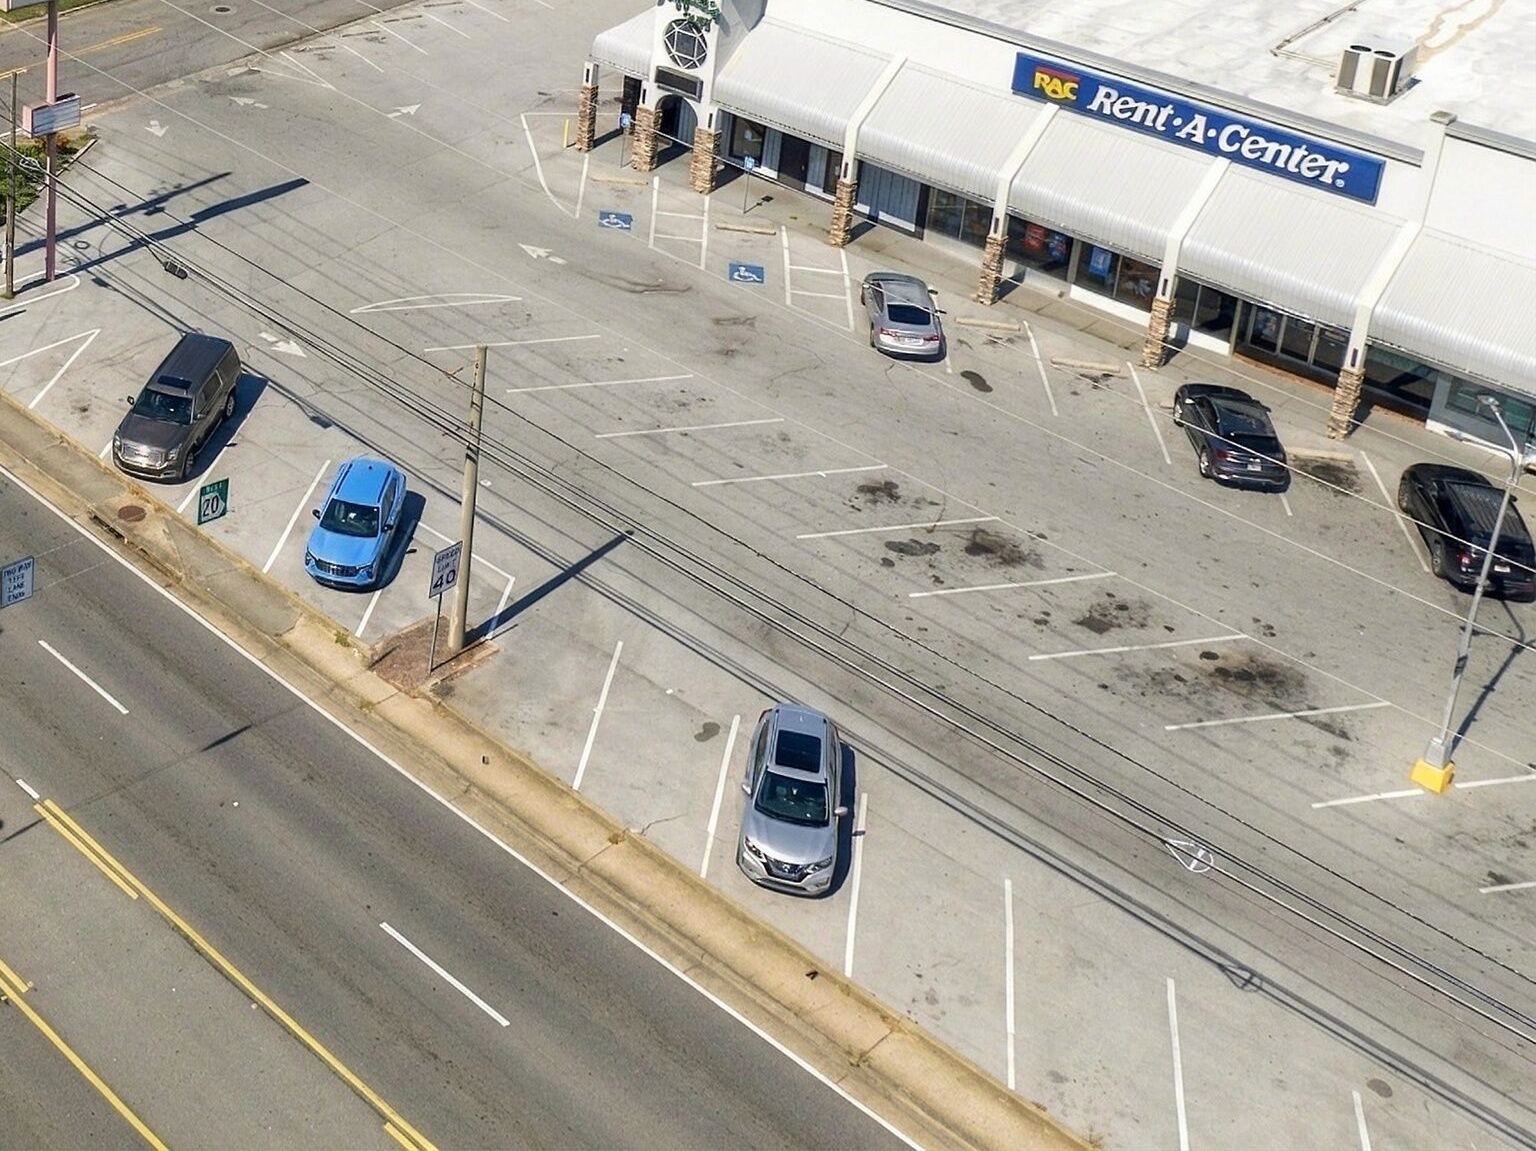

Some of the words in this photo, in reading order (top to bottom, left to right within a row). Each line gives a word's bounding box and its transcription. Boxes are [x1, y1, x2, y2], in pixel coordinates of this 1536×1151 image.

[1033, 71, 1080, 101] RAC
[202, 494, 220, 518] 20
[436, 547, 460, 564] SPEED
[18, 560, 33, 573] WAY
[437, 558, 457, 573] LIMIT
[9, 572, 25, 584] LEFT
[432, 568, 457, 590] 40
[7, 581, 25, 594] LANE
[7, 591, 26, 603] ENDS
